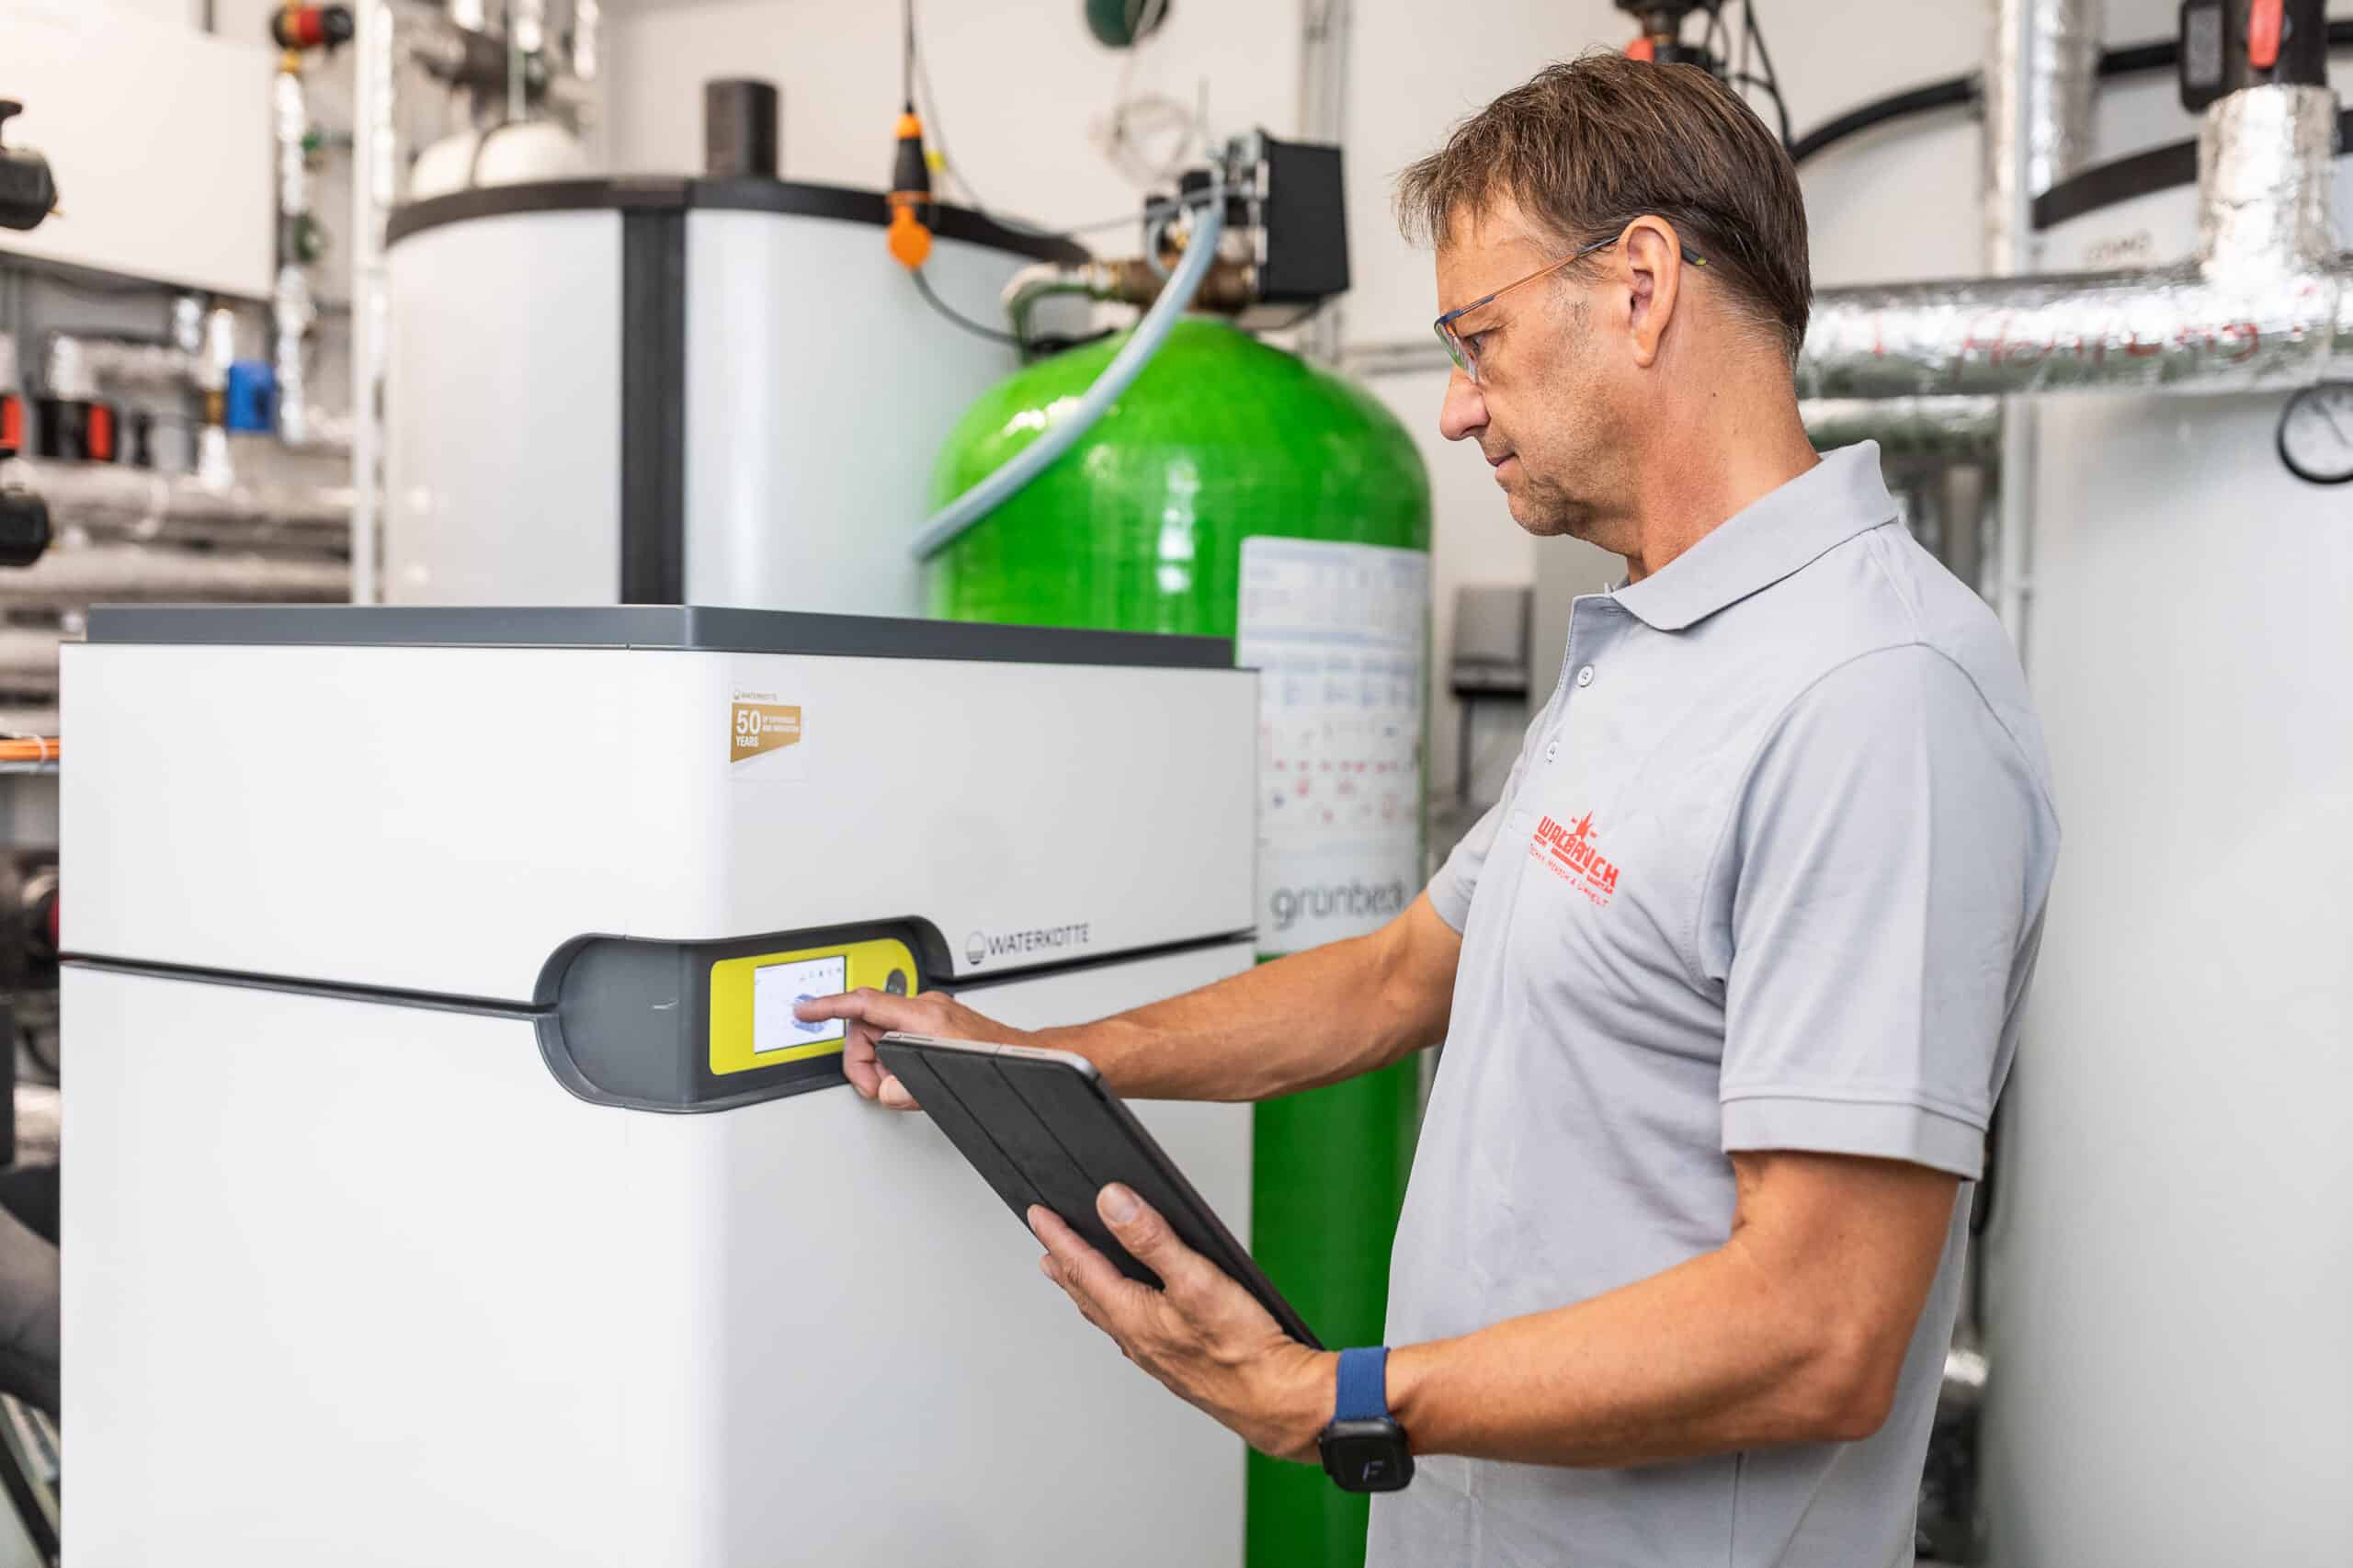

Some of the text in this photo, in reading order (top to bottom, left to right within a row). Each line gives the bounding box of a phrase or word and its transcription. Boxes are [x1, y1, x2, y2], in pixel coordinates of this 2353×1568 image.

[736, 710, 761, 734] 50
[735, 735, 759, 747] YEARS
[987, 922, 1089, 955] WATERKOTTE
